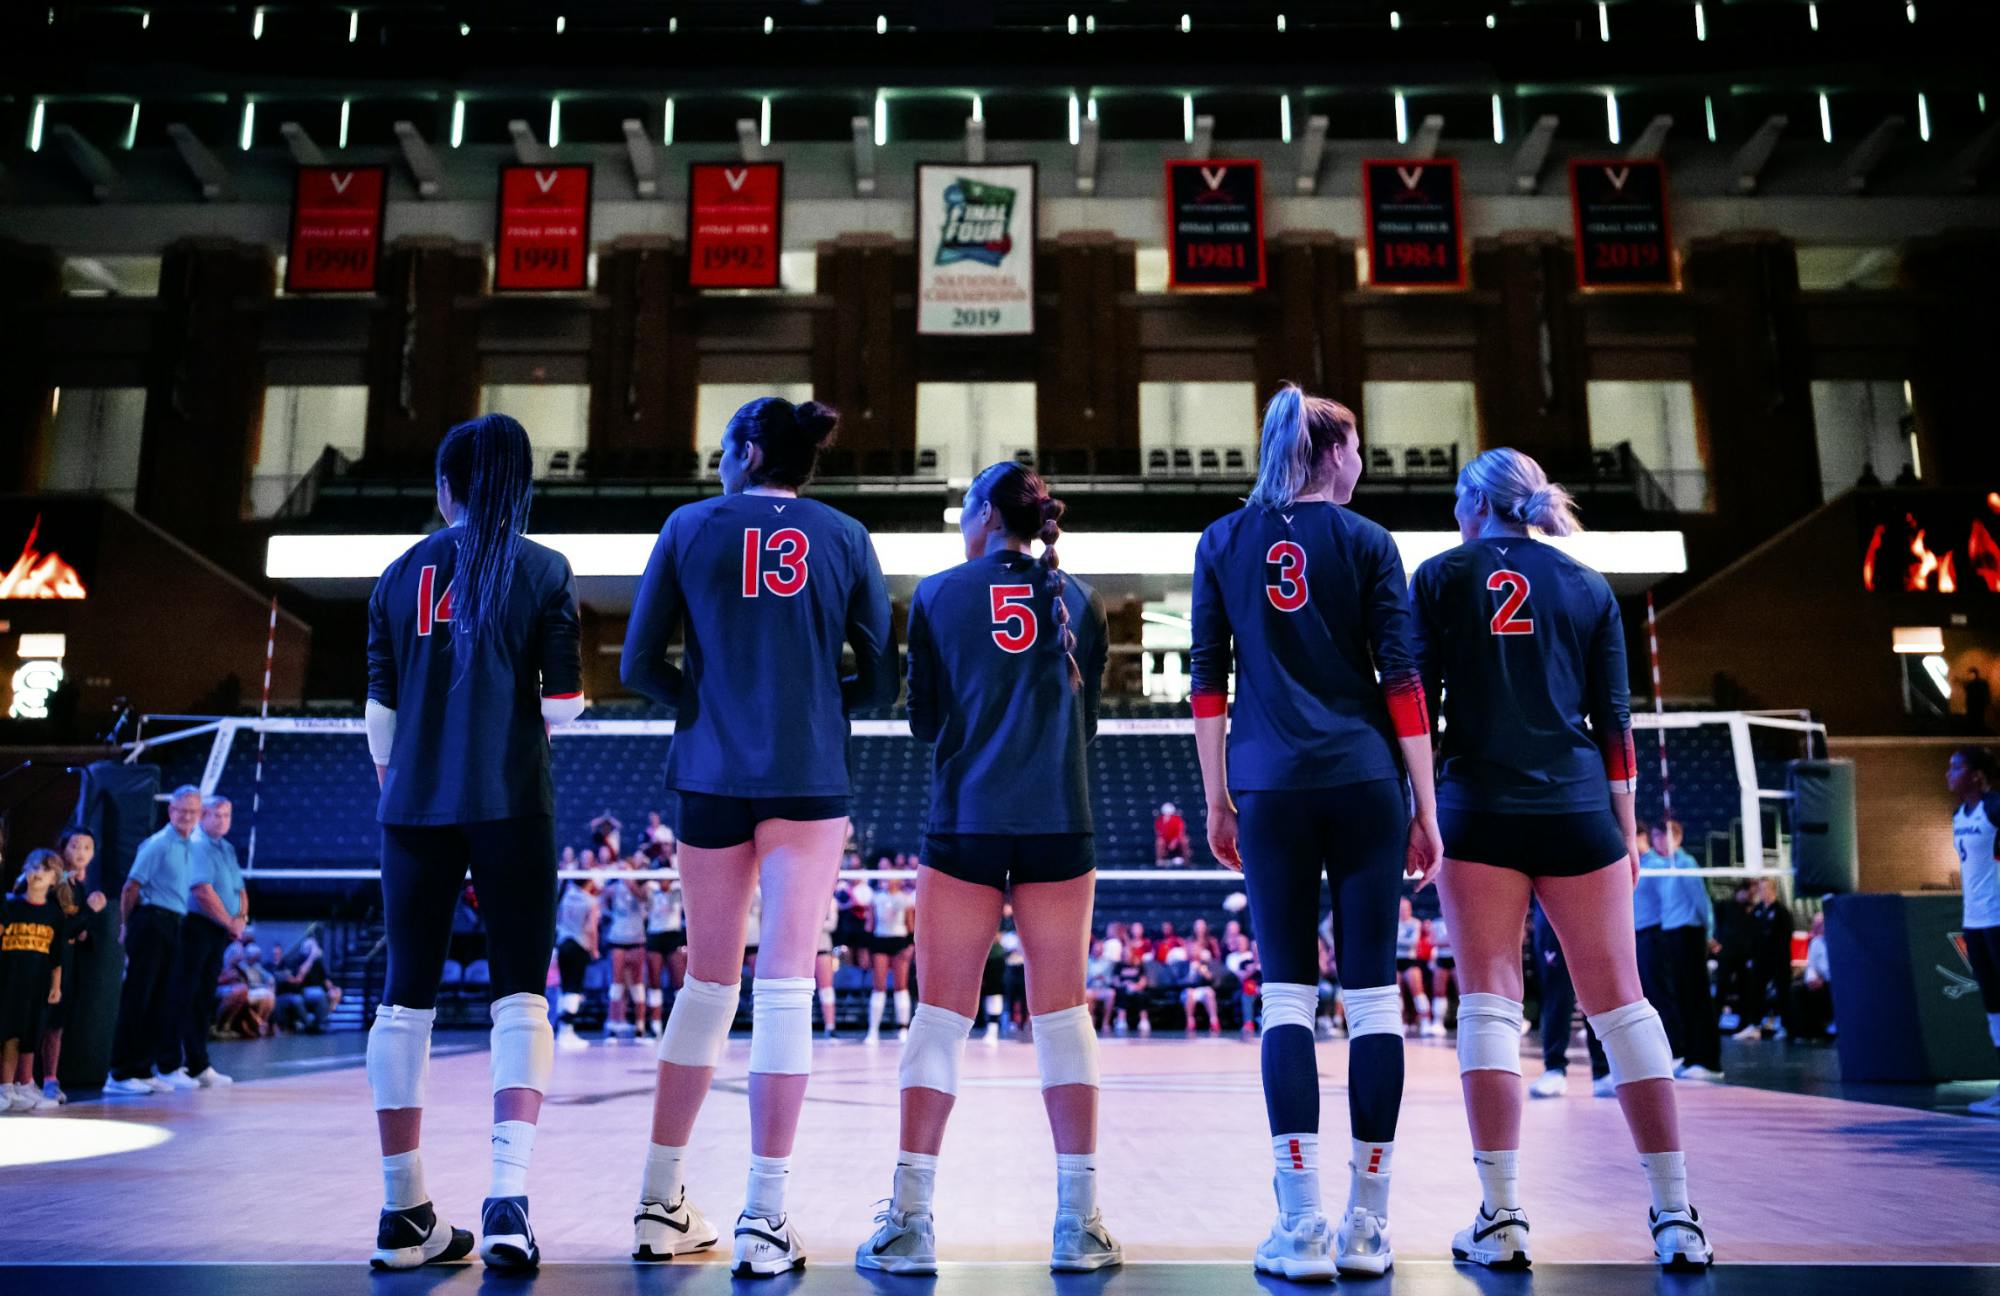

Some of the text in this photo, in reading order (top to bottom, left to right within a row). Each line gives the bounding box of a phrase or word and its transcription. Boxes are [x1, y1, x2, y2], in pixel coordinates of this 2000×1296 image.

[949, 203, 1008, 223] FINAL
[945, 221, 1005, 244] FOUR
[304, 247, 368, 271] 1990
[513, 246, 570, 271] 1991
[704, 244, 765, 269] 1992
[1186, 241, 1245, 269] 1981
[1384, 241, 1446, 269] 1984
[1592, 241, 1660, 269] 2019
[952, 308, 1001, 327] 2019
[742, 527, 810, 598] 13
[1266, 540, 1309, 612] 3
[1487, 569, 1534, 635] 2
[990, 583, 1038, 654] 5
